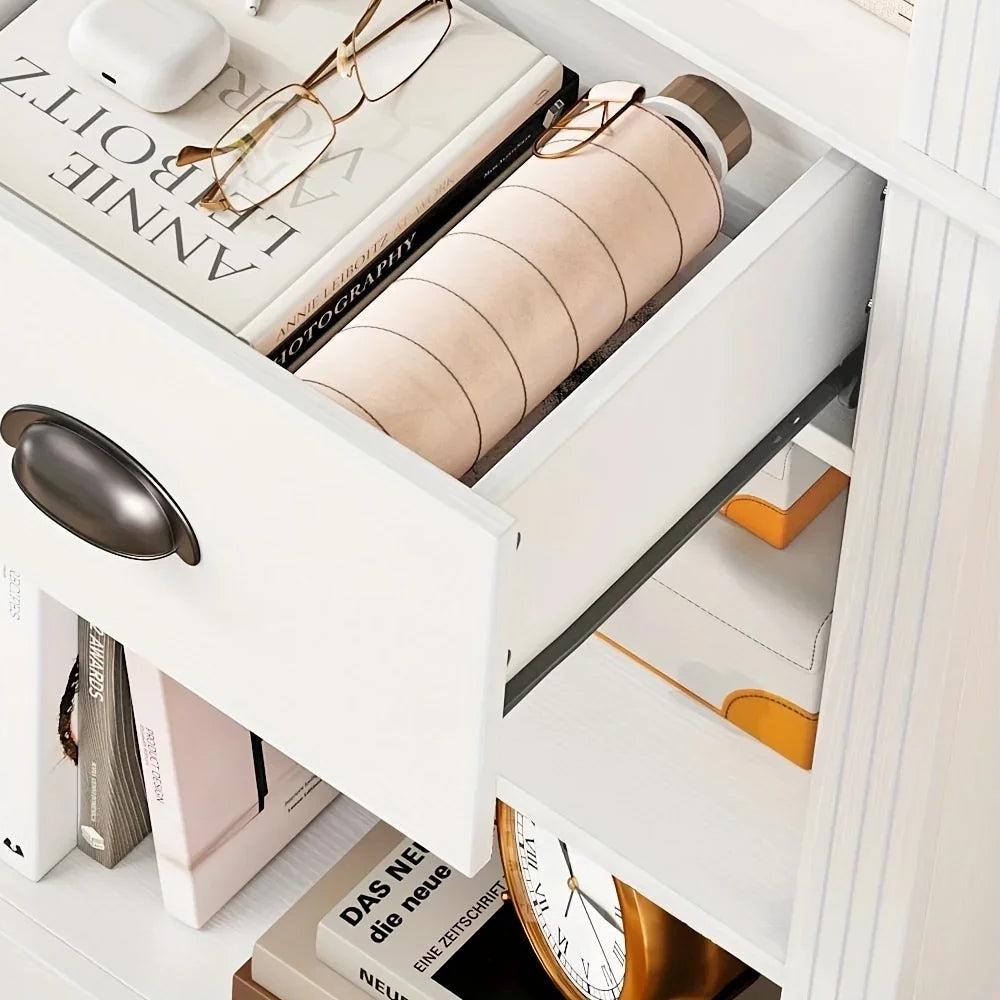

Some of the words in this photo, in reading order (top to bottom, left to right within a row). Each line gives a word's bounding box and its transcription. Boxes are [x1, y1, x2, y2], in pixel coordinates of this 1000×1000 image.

[48, 151, 260, 281] ANNIE
[276, 296, 320, 343] ANNIE
[88, 636, 106, 702] AWARDS
[145, 727, 160, 771] PRODUCT
[151, 769, 164, 804] DESIGN
[339, 879, 392, 927] DAS
[369, 912, 403, 944] die
[400, 864, 452, 913] neue
[413, 945, 443, 973] EINE
[438, 880, 507, 949] ZEITSCHRIFT
[360, 967, 409, 1000] NEU
